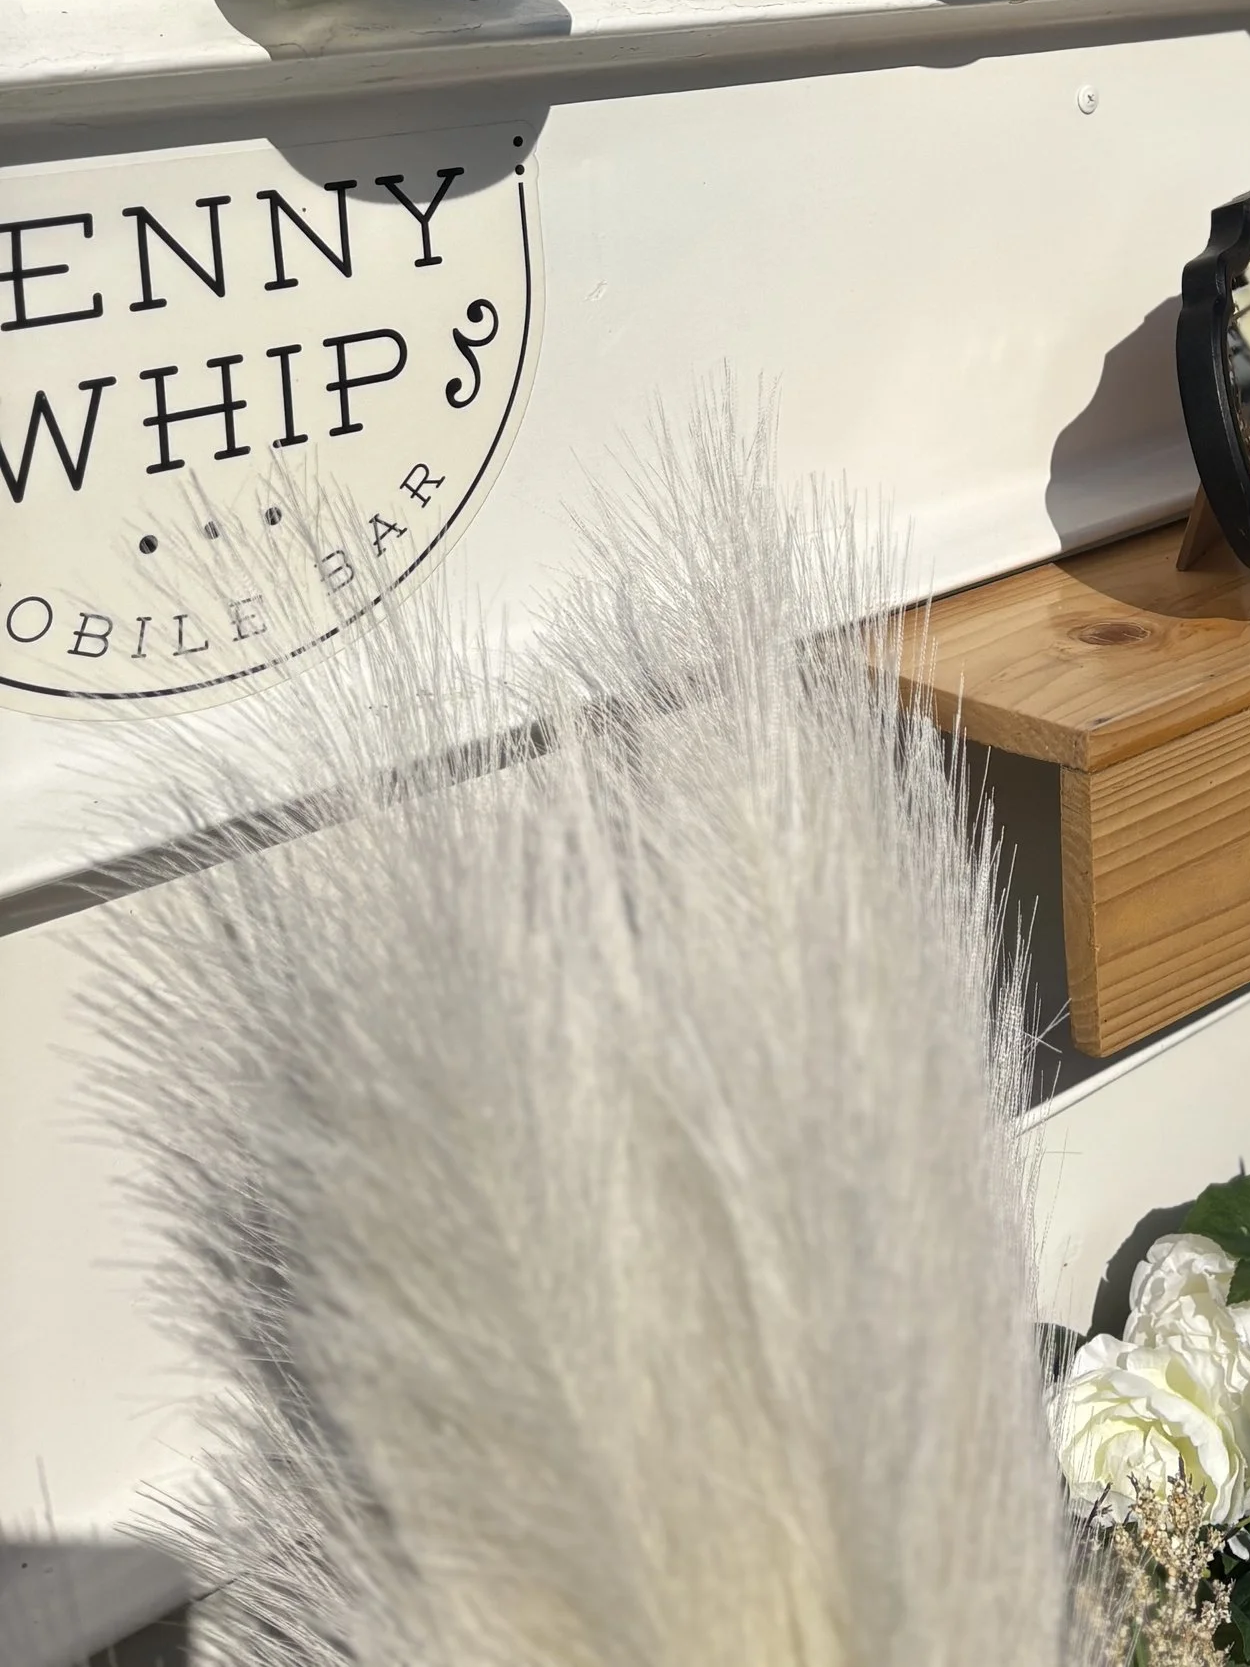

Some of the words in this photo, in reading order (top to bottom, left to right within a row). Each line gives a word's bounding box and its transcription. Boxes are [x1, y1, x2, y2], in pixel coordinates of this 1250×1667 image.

[0, 166, 465, 331] ENNY
[0, 327, 408, 503] WHIP
[314, 463, 446, 597] BAR
